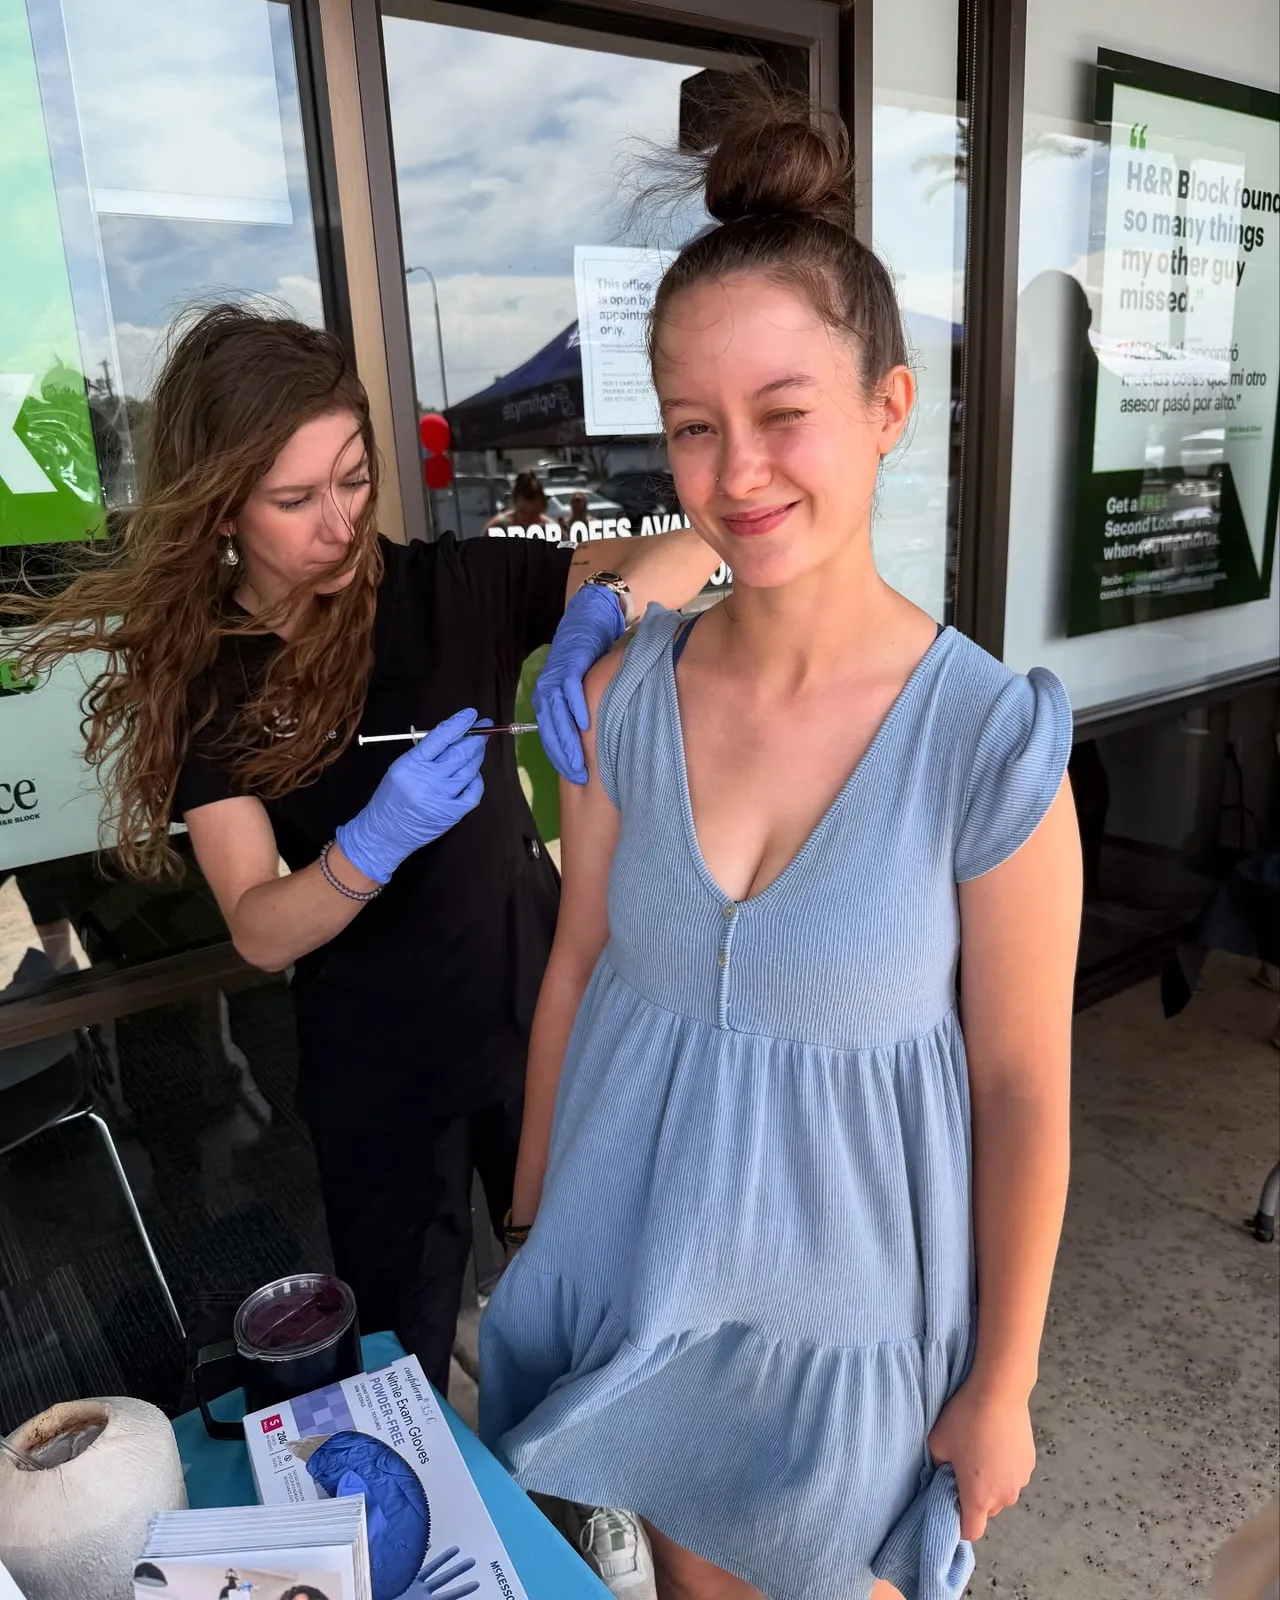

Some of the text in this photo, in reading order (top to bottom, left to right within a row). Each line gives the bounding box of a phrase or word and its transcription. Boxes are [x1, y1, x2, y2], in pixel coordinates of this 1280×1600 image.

[1127, 161, 1172, 197] H&R
[1178, 170, 1231, 204] Block
[1124, 208, 1264, 252] so many things
[1122, 246, 1246, 287] my other guy
[597, 277, 652, 291] This office
[598, 293, 608, 305] is
[610, 296, 637, 307] open
[1230, 369, 1243, 386] mi
[1246, 370, 1267, 386] otro
[1120, 398, 1160, 413] asesor
[1162, 393, 1190, 415] pasó
[1192, 399, 1213, 414] por
[1106, 496, 1130, 514] Get
[1130, 499, 1138, 512] a
[1104, 516, 1150, 538] Second
[1103, 541, 1135, 560] when
[14, 813, 40, 823] BLOCK
[370, 1376, 405, 1447] POWDER-FREE
[385, 1370, 430, 1465] Nitrile Exam Gloves
[269, 1418, 280, 1427] S
